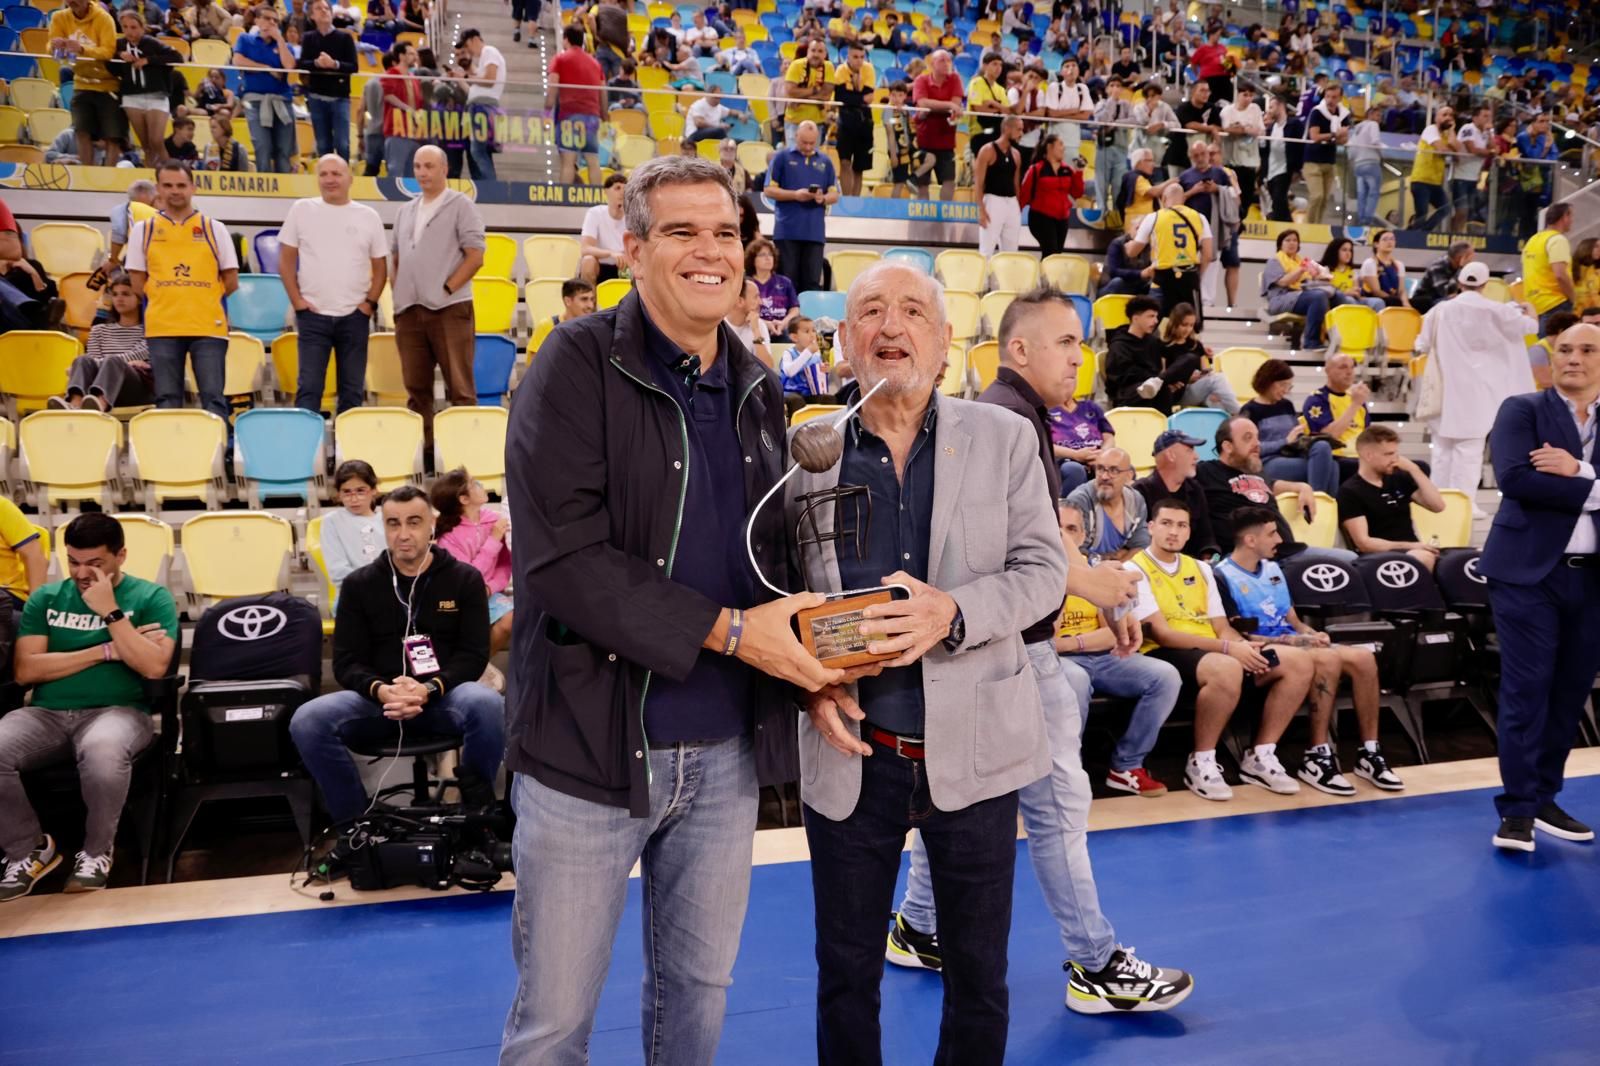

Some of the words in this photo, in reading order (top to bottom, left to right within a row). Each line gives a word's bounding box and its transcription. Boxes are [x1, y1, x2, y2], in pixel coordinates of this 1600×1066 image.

[195, 174, 213, 191] AN
[219, 175, 280, 192] CANARIA
[528, 184, 564, 202] GRAN
[567, 186, 609, 204] CANAR
[907, 202, 938, 217] GRAN
[941, 204, 978, 219] CANAR
[1172, 223, 1189, 248] 5
[439, 600, 456, 609] FIBA
[46, 608, 134, 631] CARHAT
